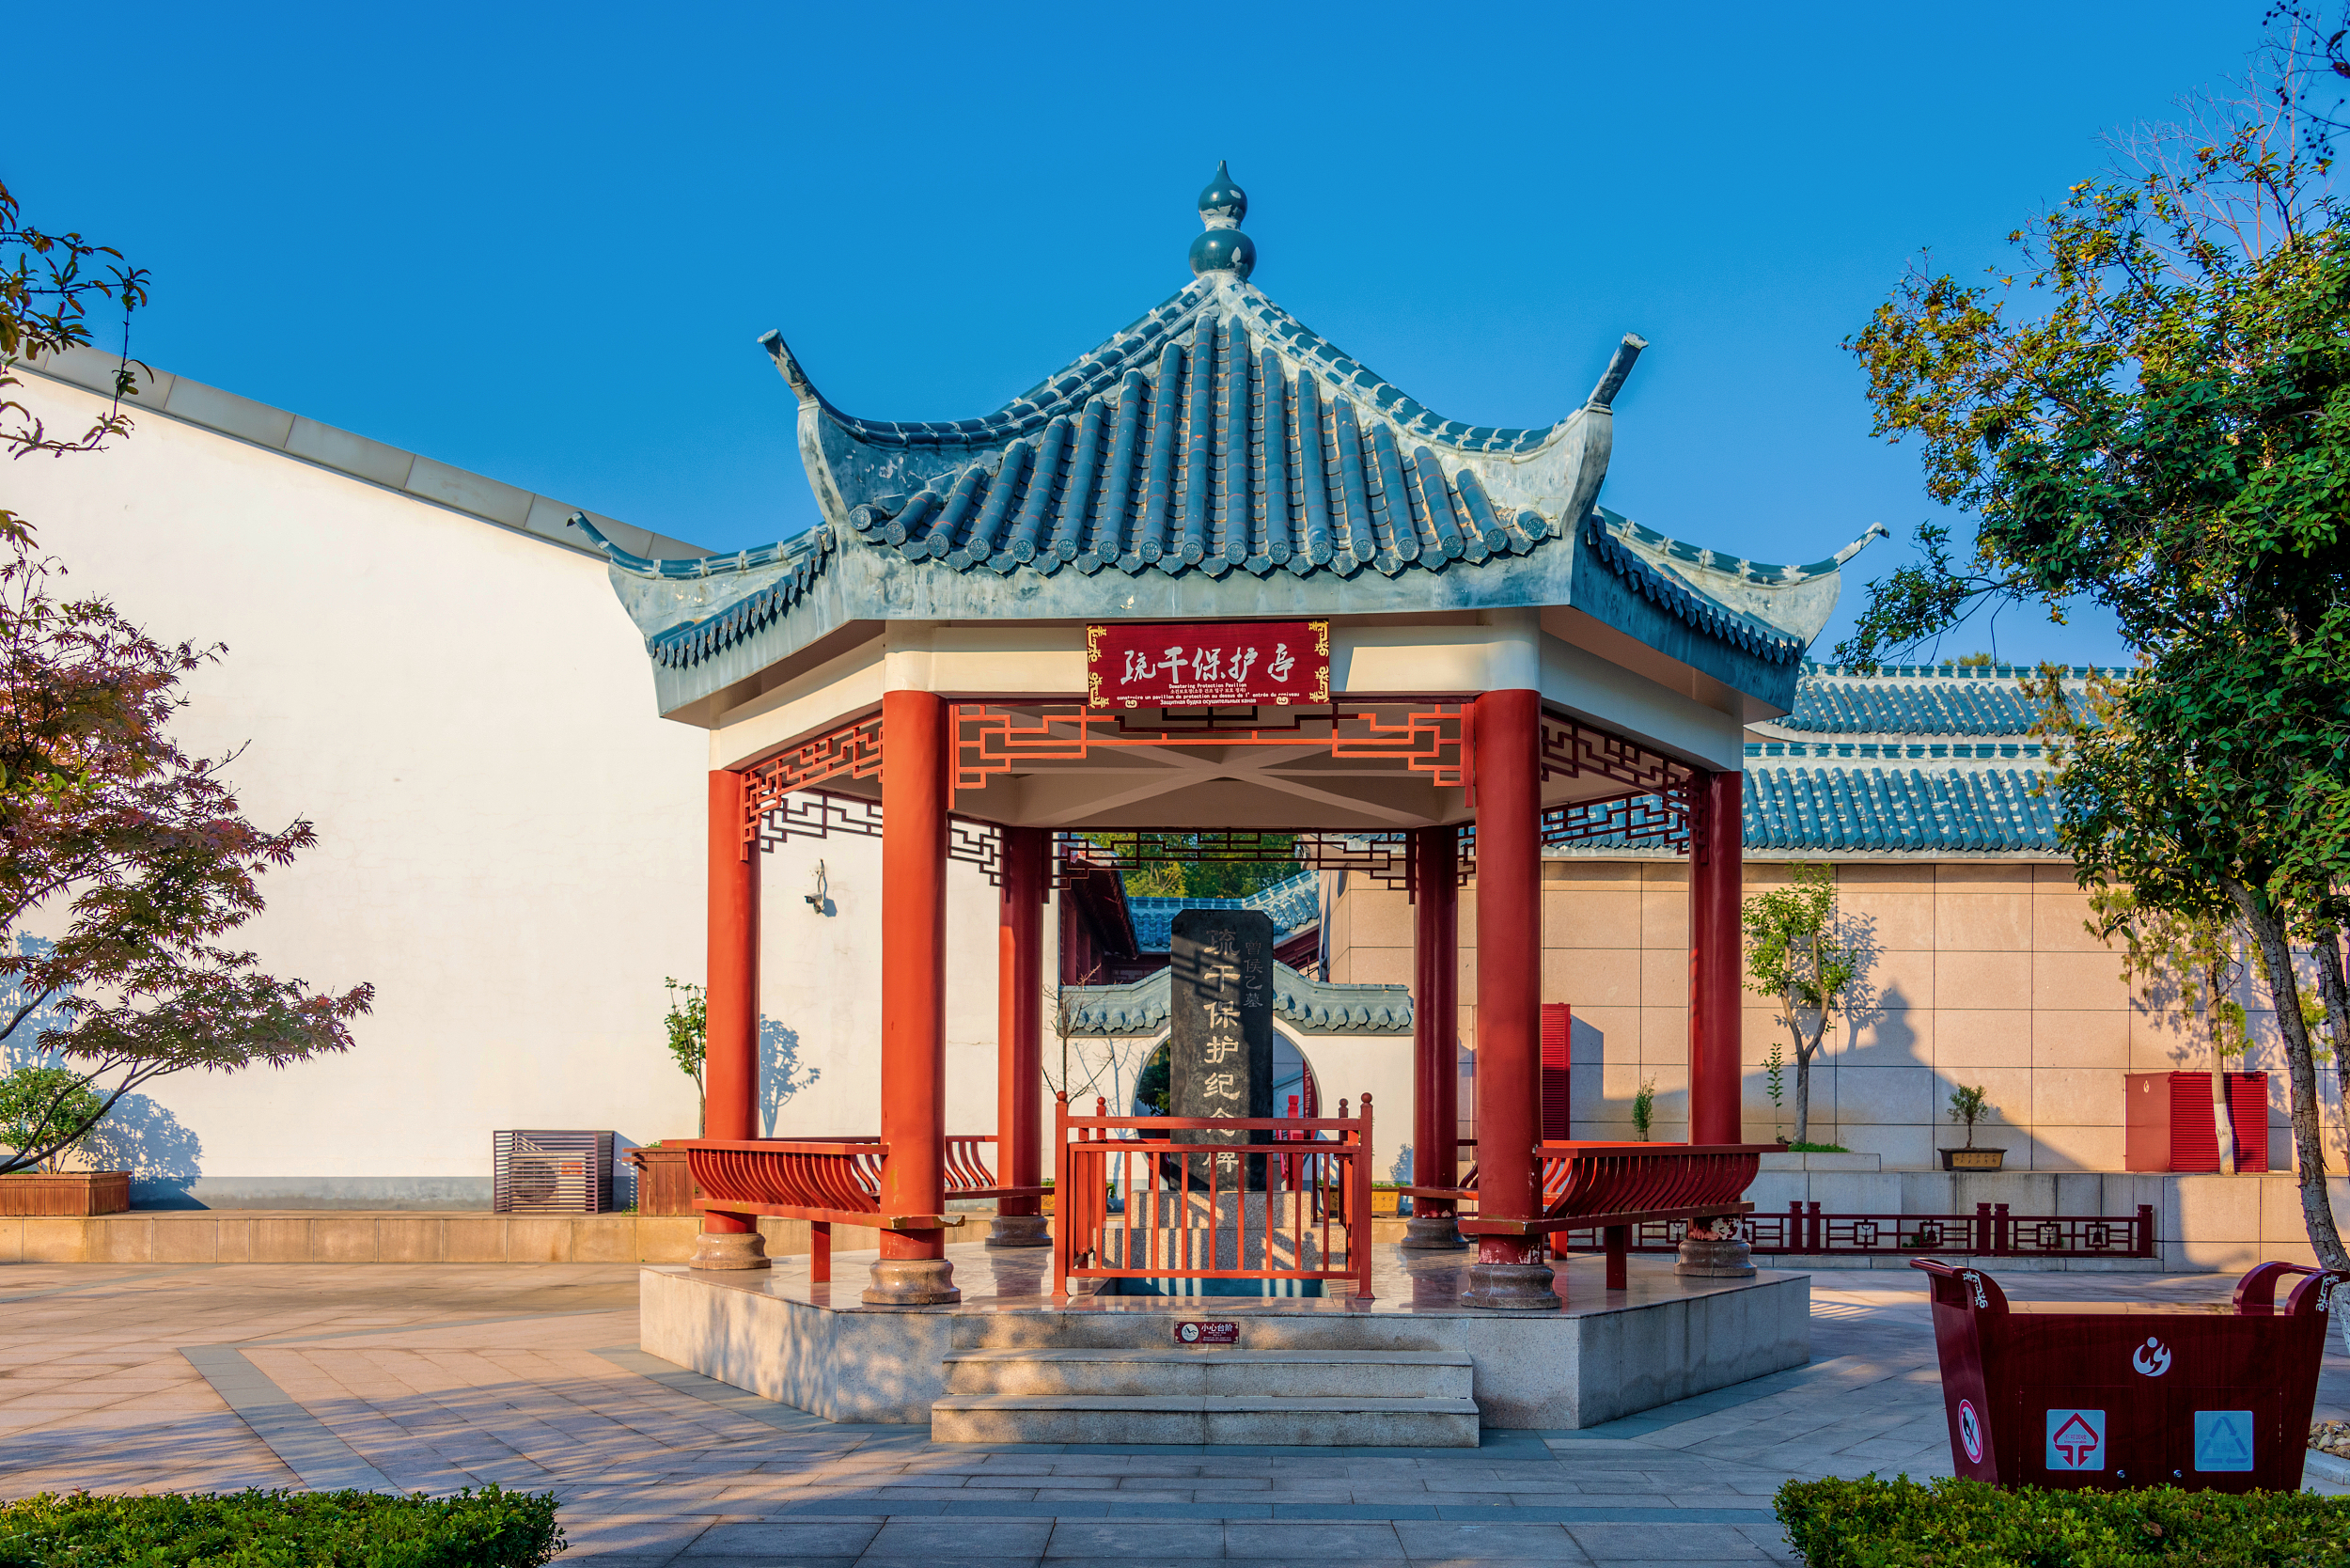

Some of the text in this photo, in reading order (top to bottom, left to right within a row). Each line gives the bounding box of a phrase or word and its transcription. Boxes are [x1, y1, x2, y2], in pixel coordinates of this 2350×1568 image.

[1120, 643, 1295, 685] 疏干保护亭
[1243, 941, 1263, 1008] 曾侯乙墓
[1201, 1324, 1233, 1332] 小心台阶
